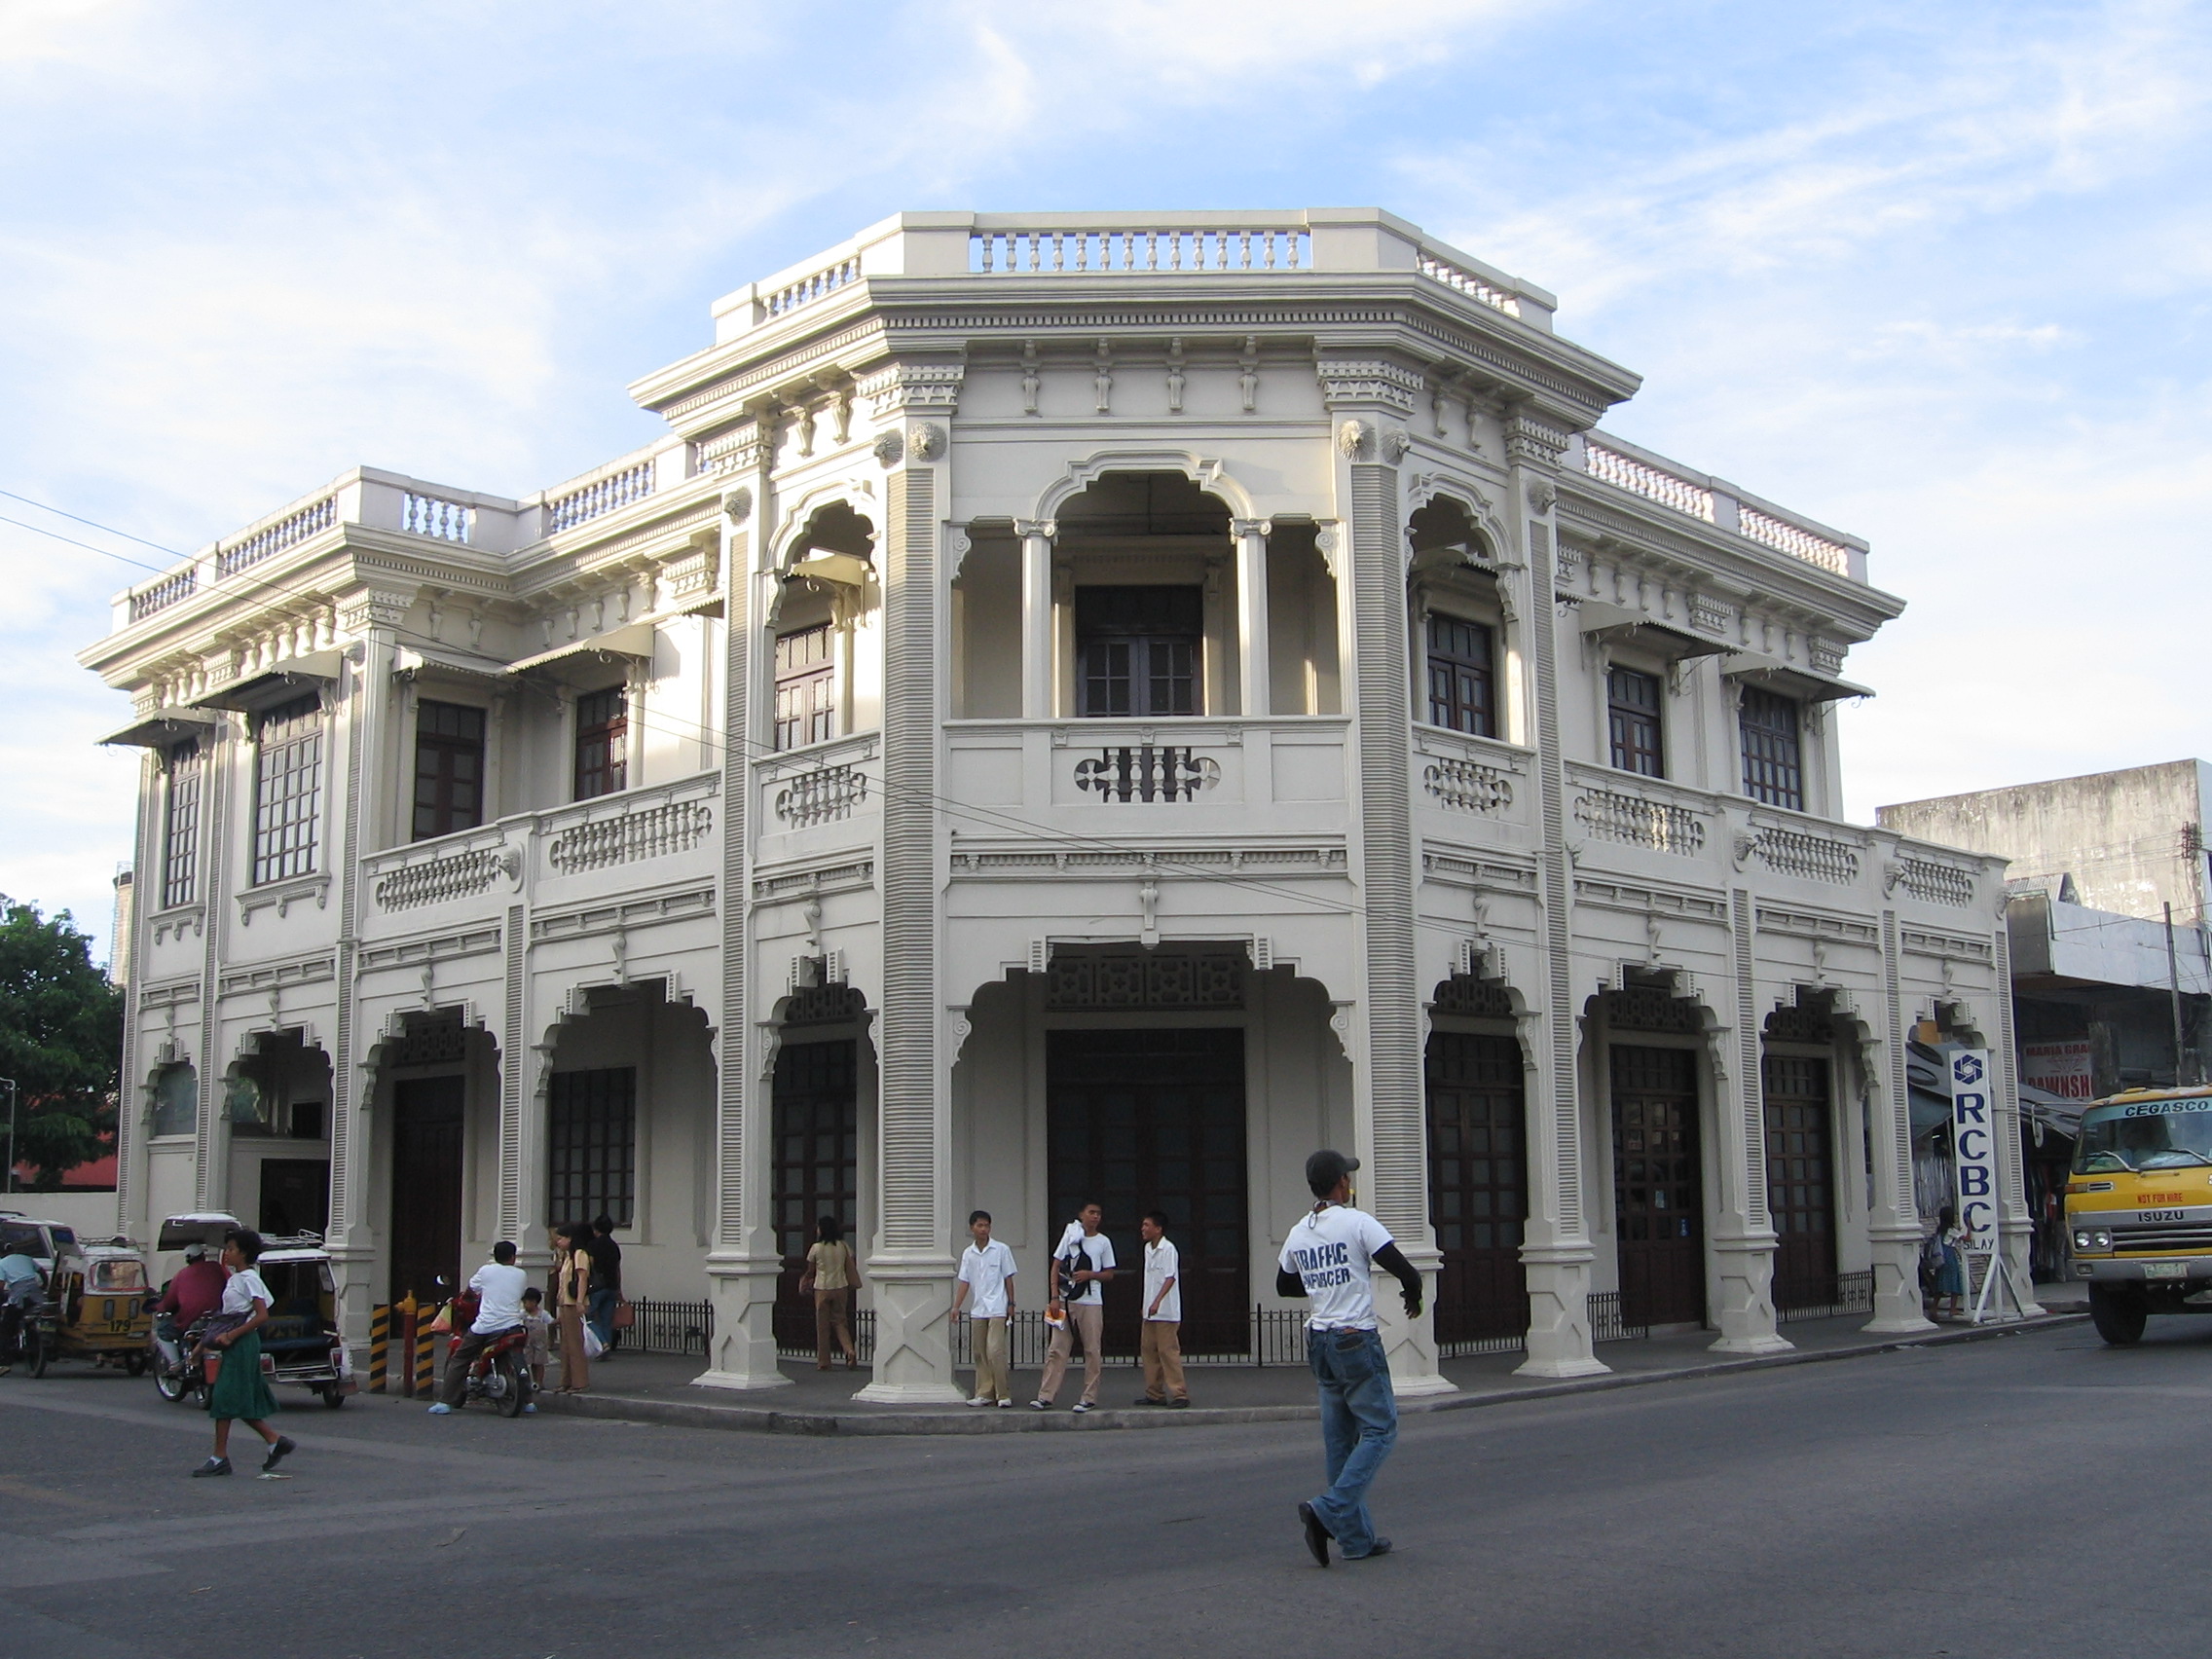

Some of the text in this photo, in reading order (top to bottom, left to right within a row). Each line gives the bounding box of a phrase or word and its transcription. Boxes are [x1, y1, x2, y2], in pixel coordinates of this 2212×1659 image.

[2026, 1044, 2089, 1056] MARIA GRA
[2028, 1075, 2093, 1098] PAWNSH
[2124, 1100, 2209, 1117] CEGASCO
[1956, 1092, 1991, 1233] RCBC
[2138, 1193, 2183, 1204] NOT FOR HIRE
[2138, 1210, 2184, 1222] ISUZU
[1963, 1238, 1995, 1250] SILAY
[1294, 1242, 1348, 1272] TRAFFIC
[1304, 1268, 1350, 1289] NFORCER
[110, 1319, 131, 1332] 179
